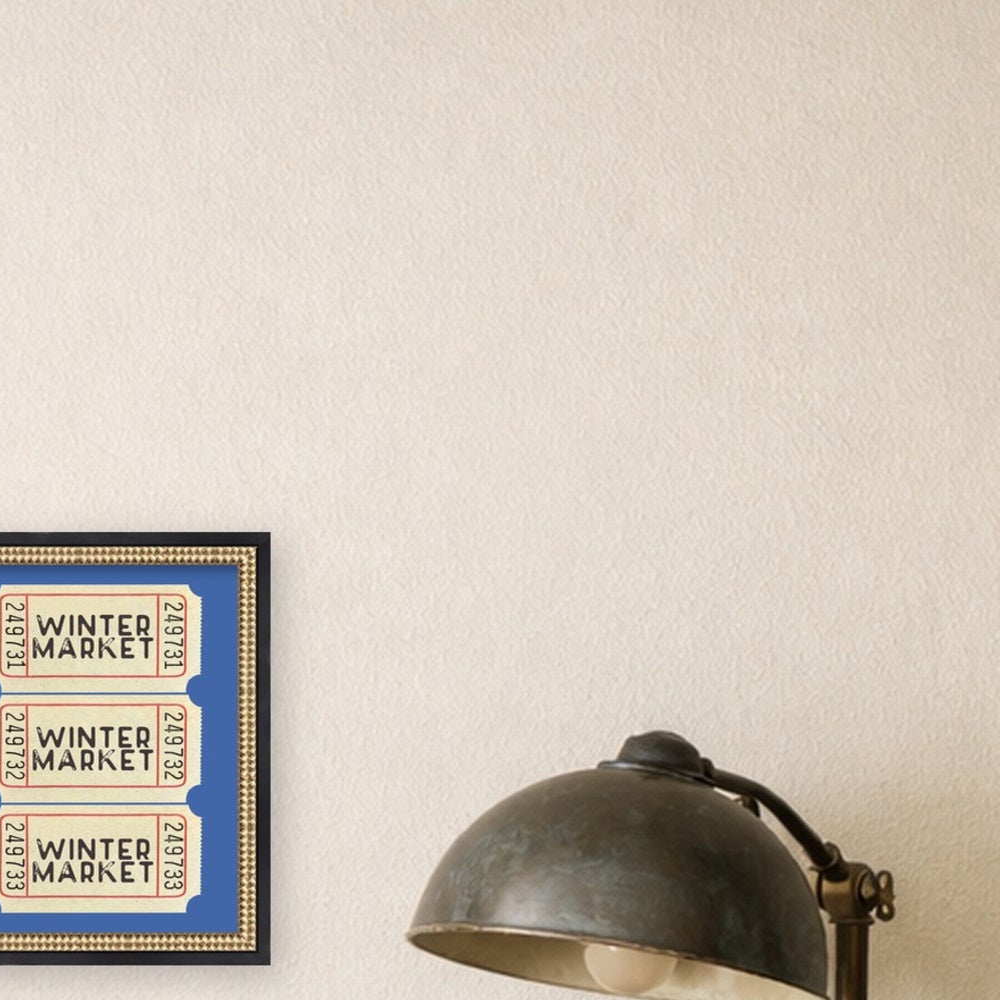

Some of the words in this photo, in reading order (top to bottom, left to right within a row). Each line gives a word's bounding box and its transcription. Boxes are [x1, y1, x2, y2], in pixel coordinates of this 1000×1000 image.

[4, 602, 25, 670] 249731
[32, 636, 154, 660] MARKET
[36, 614, 151, 636] WINTER
[163, 602, 184, 670] 249731
[4, 712, 25, 780] 249732
[32, 748, 154, 771] MARKET
[36, 726, 151, 748] WINTER
[163, 712, 184, 780] 249732
[4, 822, 25, 891] 249733
[32, 860, 154, 883] MARKET
[36, 838, 151, 860] WINTER
[163, 822, 184, 890] 249733
